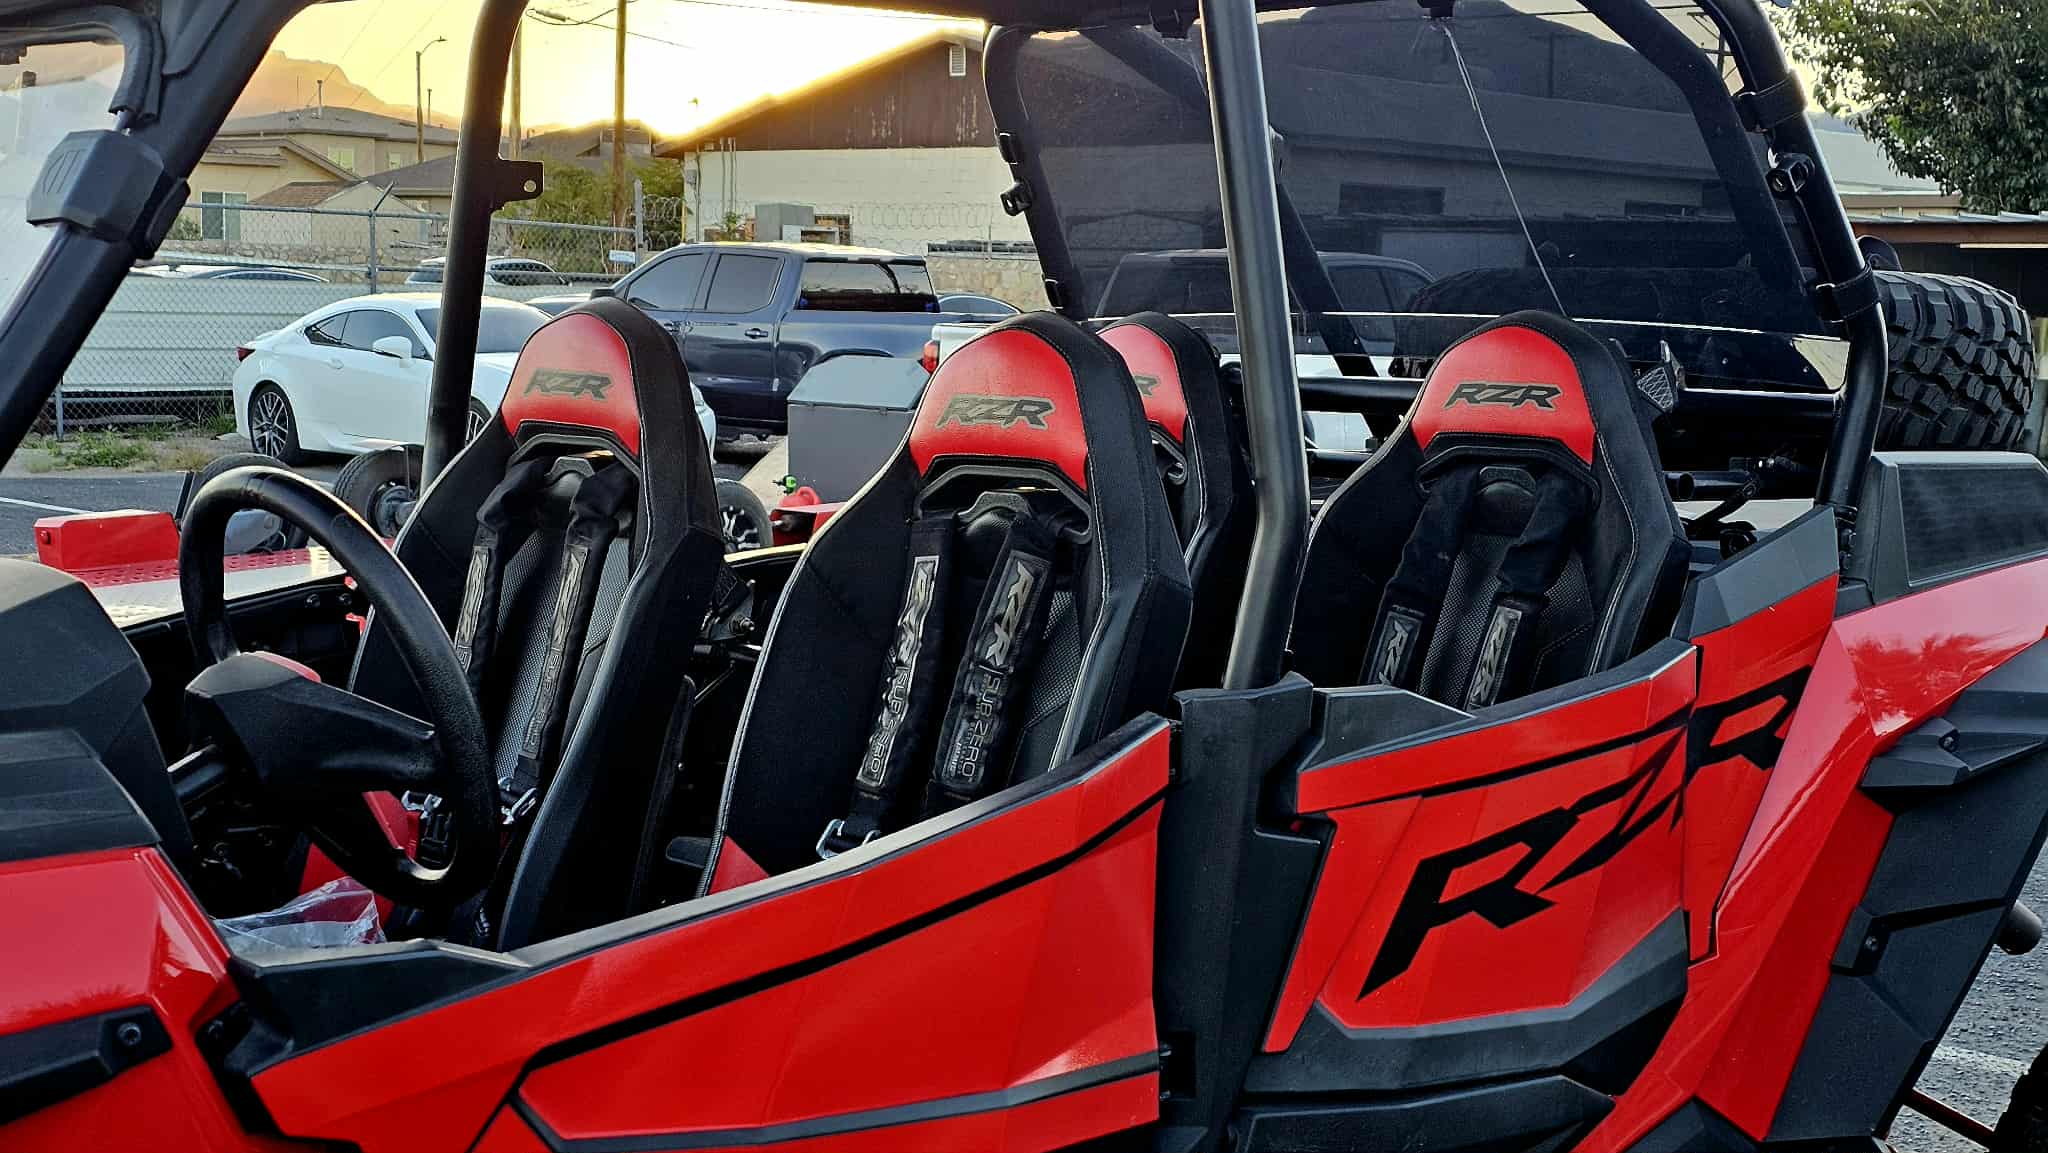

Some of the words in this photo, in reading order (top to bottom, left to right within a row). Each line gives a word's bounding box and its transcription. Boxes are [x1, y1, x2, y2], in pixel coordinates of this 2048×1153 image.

[523, 368, 615, 402] RZR
[1441, 381, 1563, 411] RZR
[935, 394, 1055, 430] RZR
[985, 560, 1035, 668] RZR
[1379, 620, 1409, 686] RZ
[1471, 612, 1508, 704] RZR
[890, 672, 908, 715] SUB
[980, 675, 1001, 718] SUB
[962, 720, 989, 777] ZERO
[1357, 666, 1814, 1001] RZR
